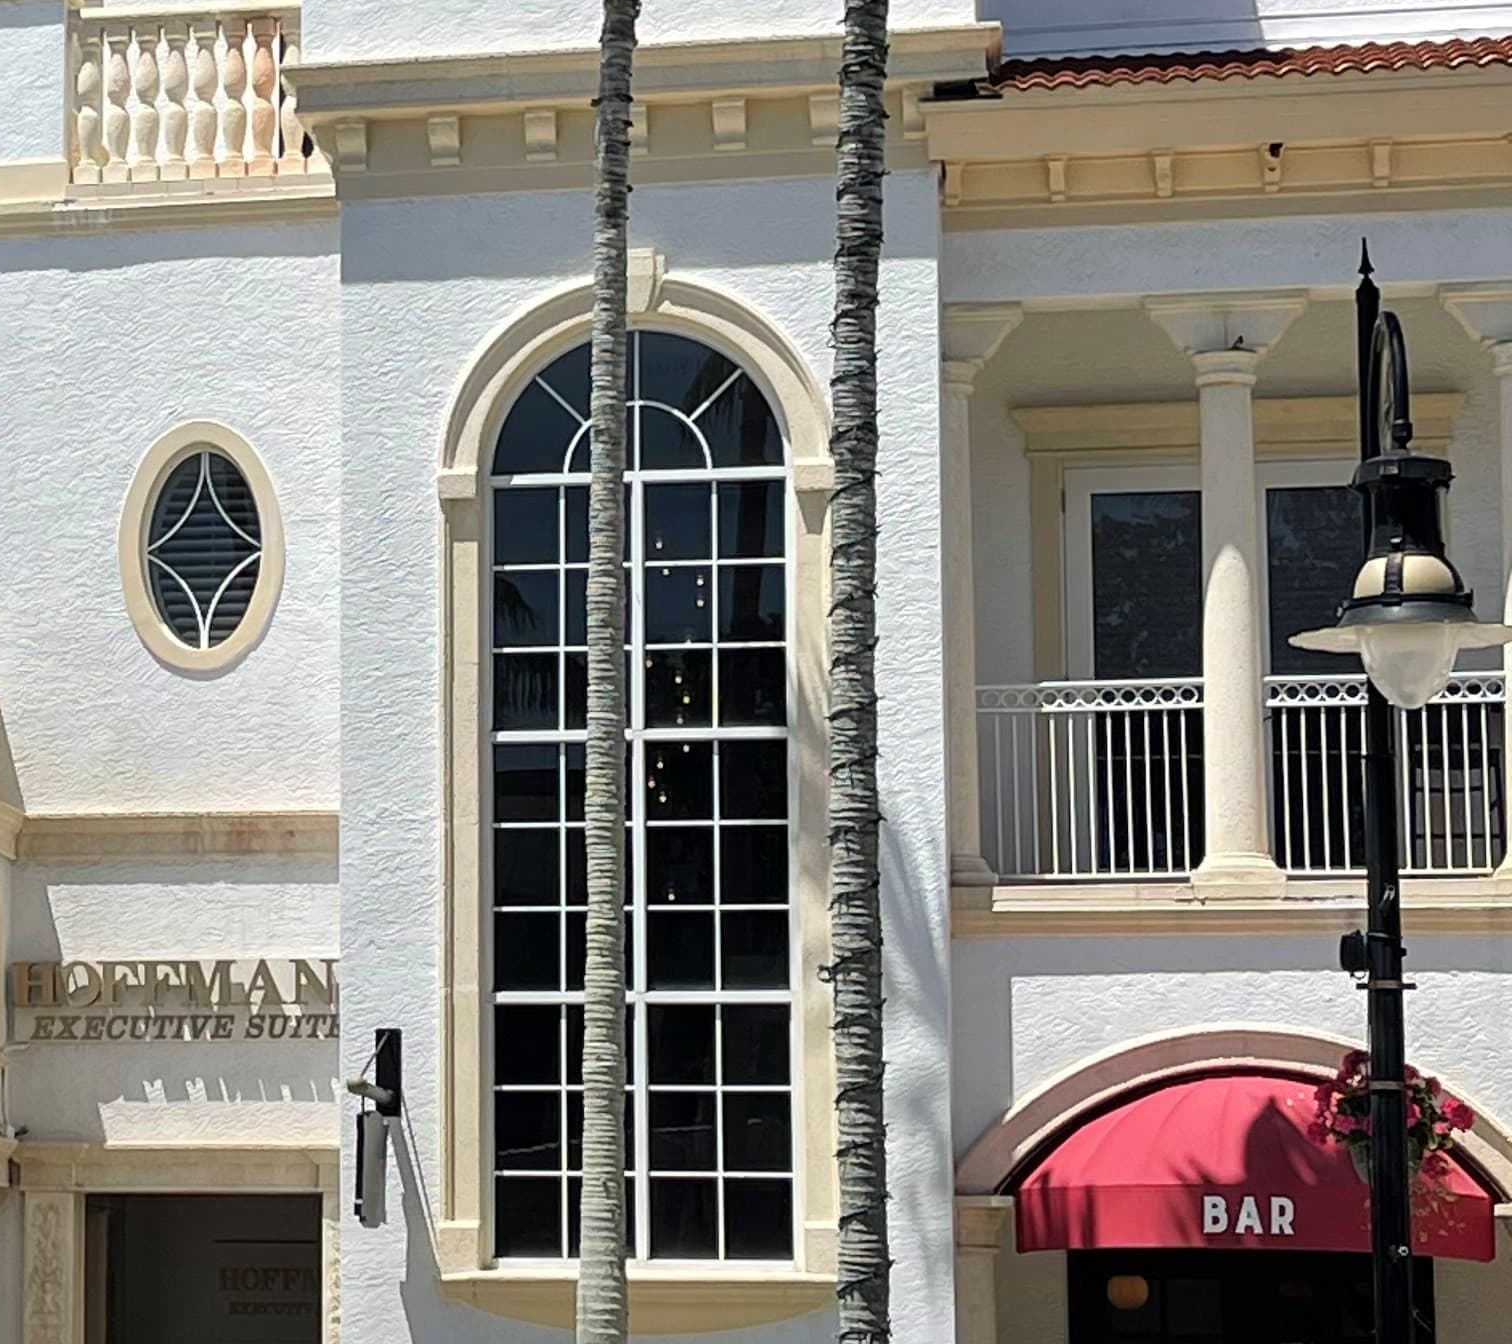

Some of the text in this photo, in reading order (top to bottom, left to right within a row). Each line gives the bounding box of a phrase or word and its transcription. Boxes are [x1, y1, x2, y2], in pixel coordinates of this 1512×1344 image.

[12, 958, 338, 1009] HOFFMAN
[30, 1014, 235, 1041] EXECUTIVE
[1202, 1195, 1295, 1235] BAR
